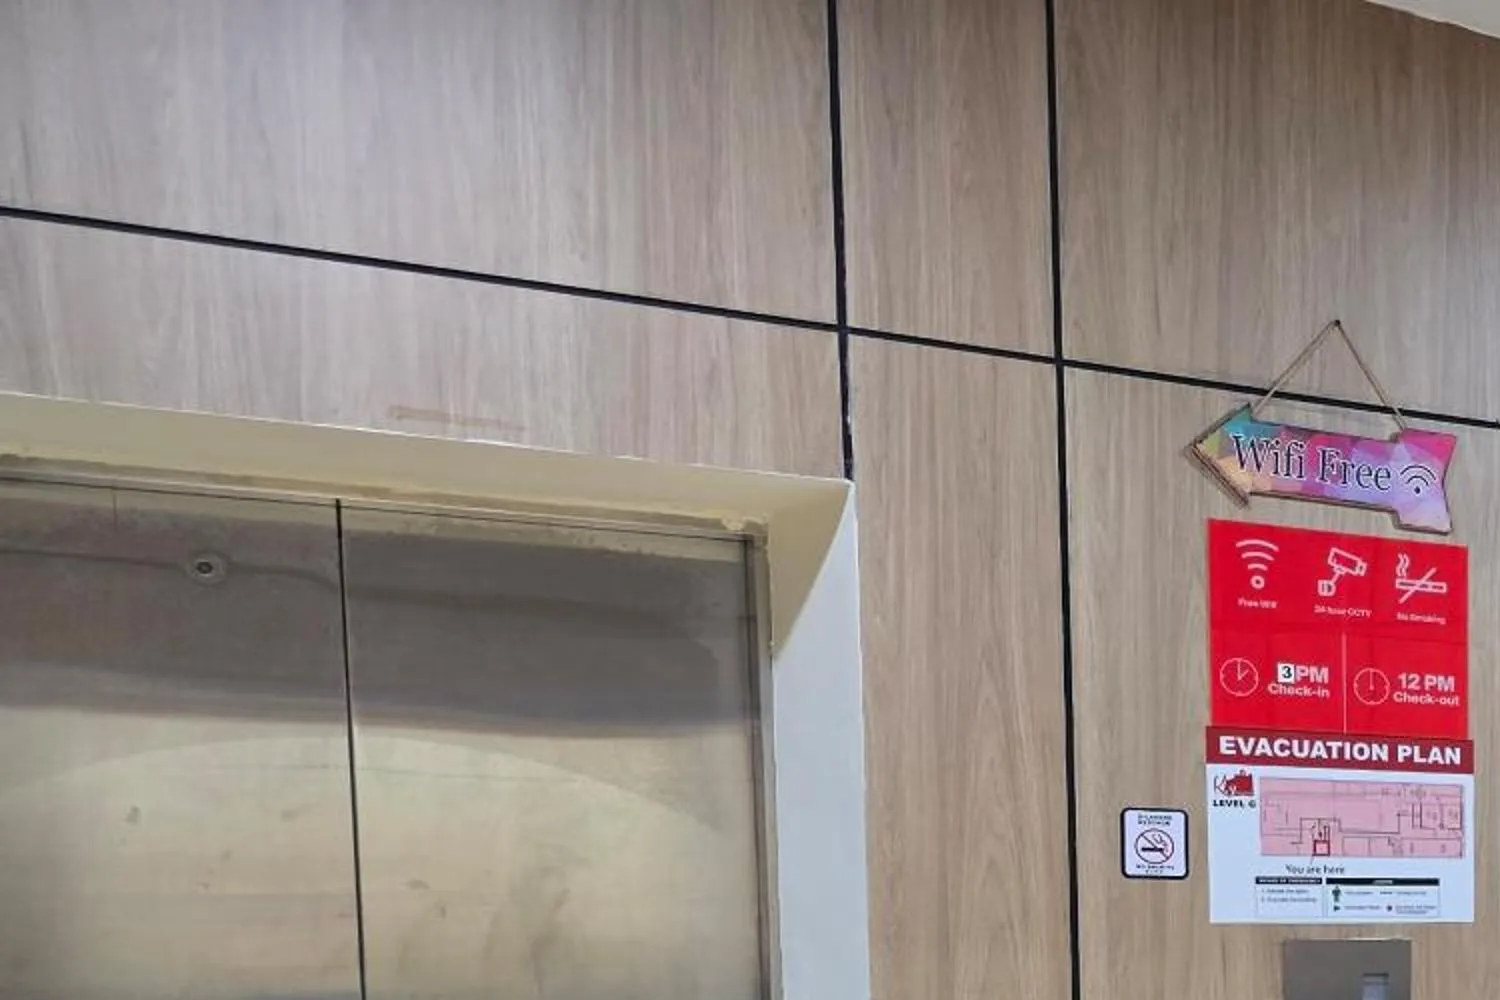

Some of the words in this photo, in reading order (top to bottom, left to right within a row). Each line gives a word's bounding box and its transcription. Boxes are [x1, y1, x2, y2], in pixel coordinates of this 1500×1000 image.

[1231, 434, 1306, 479] Wifi
[1318, 448, 1392, 492] Free
[1267, 682, 1330, 699] Check-in
[1399, 673, 1419, 690] 12
[1424, 674, 1455, 692] PM
[1393, 691, 1458, 707] Check-out
[1219, 735, 1389, 763] EVACUATION
[1398, 744, 1462, 766] PLAN
[1213, 799, 1245, 808] LEVEL
[1285, 863, 1304, 875] You
[1306, 866, 1321, 874] are
[1323, 864, 1346, 875] here
